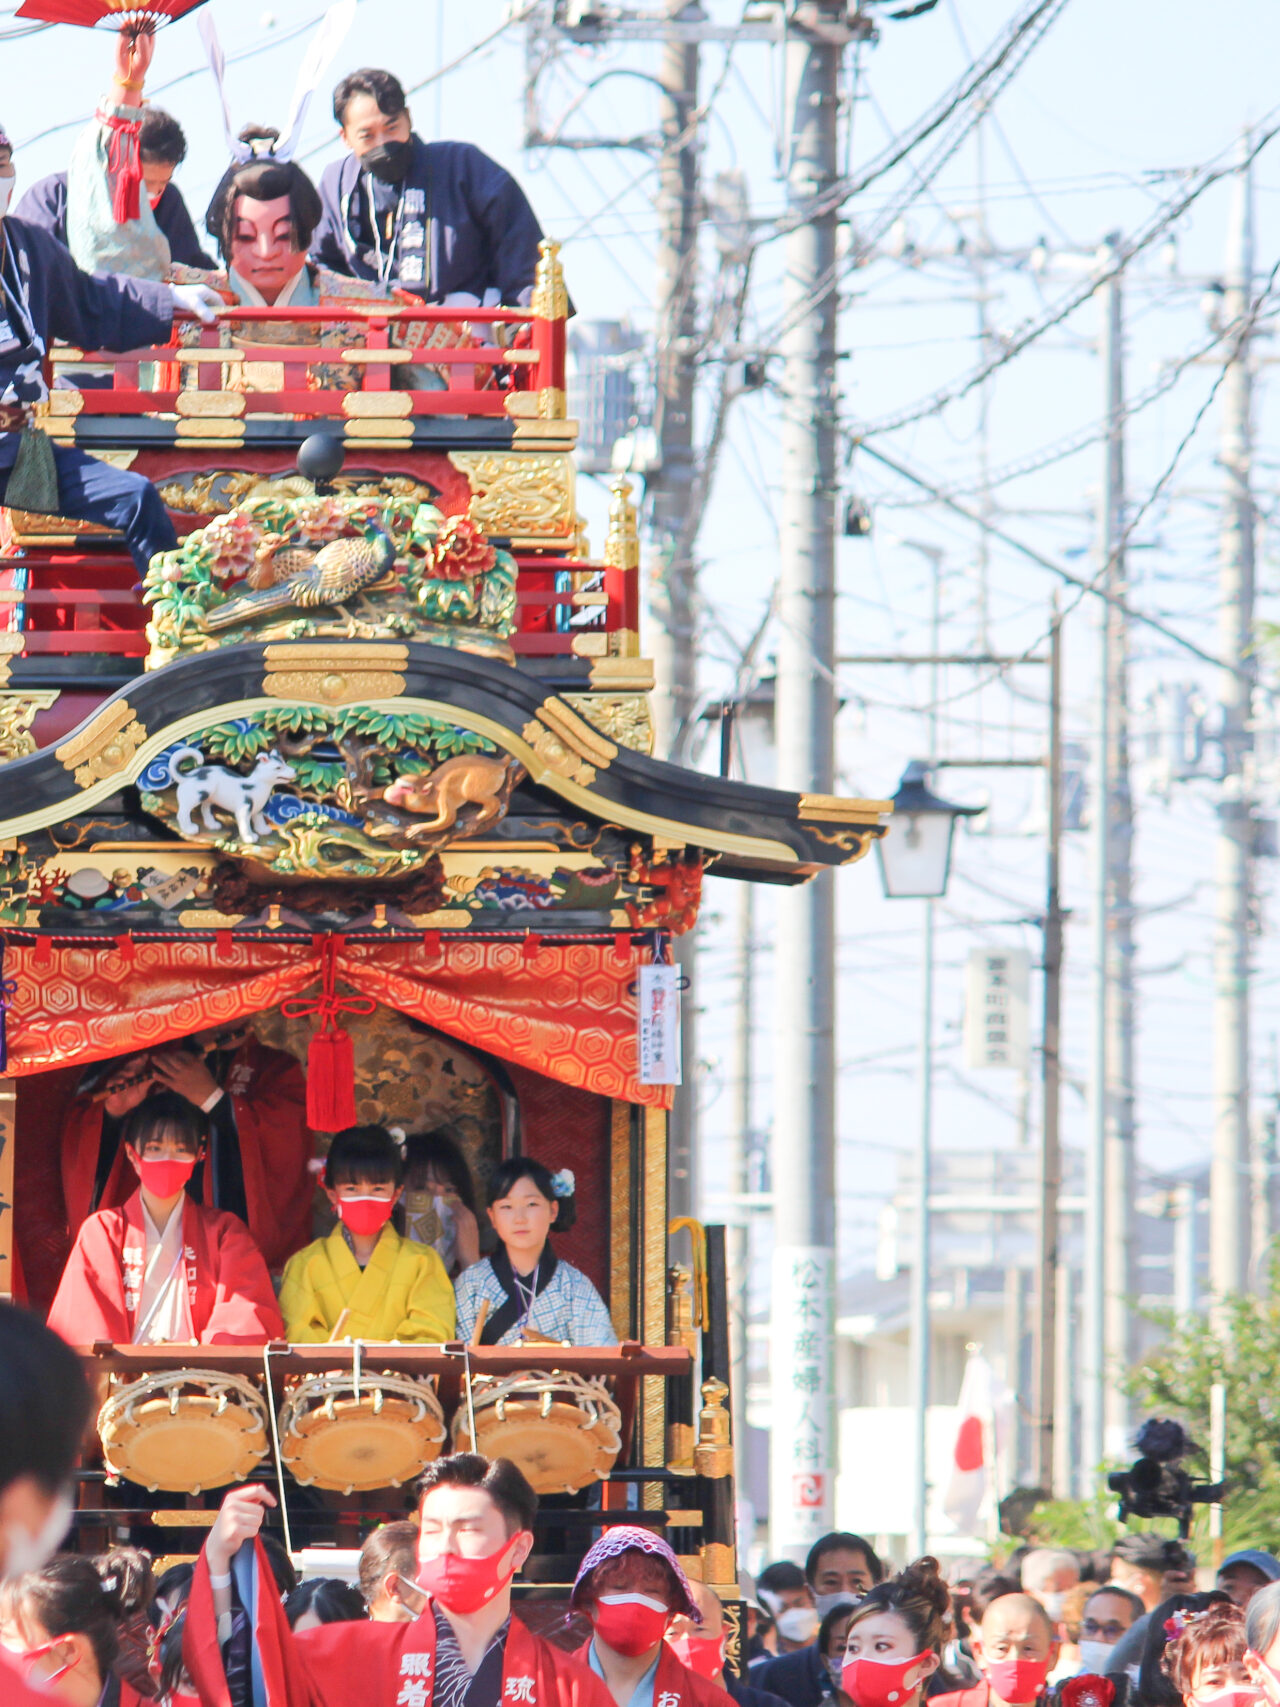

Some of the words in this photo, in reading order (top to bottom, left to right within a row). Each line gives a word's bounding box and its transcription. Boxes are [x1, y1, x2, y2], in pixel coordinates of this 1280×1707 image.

[792, 1256, 823, 1468] 松本産婦人科
[504, 1675, 537, 1705] 琉
